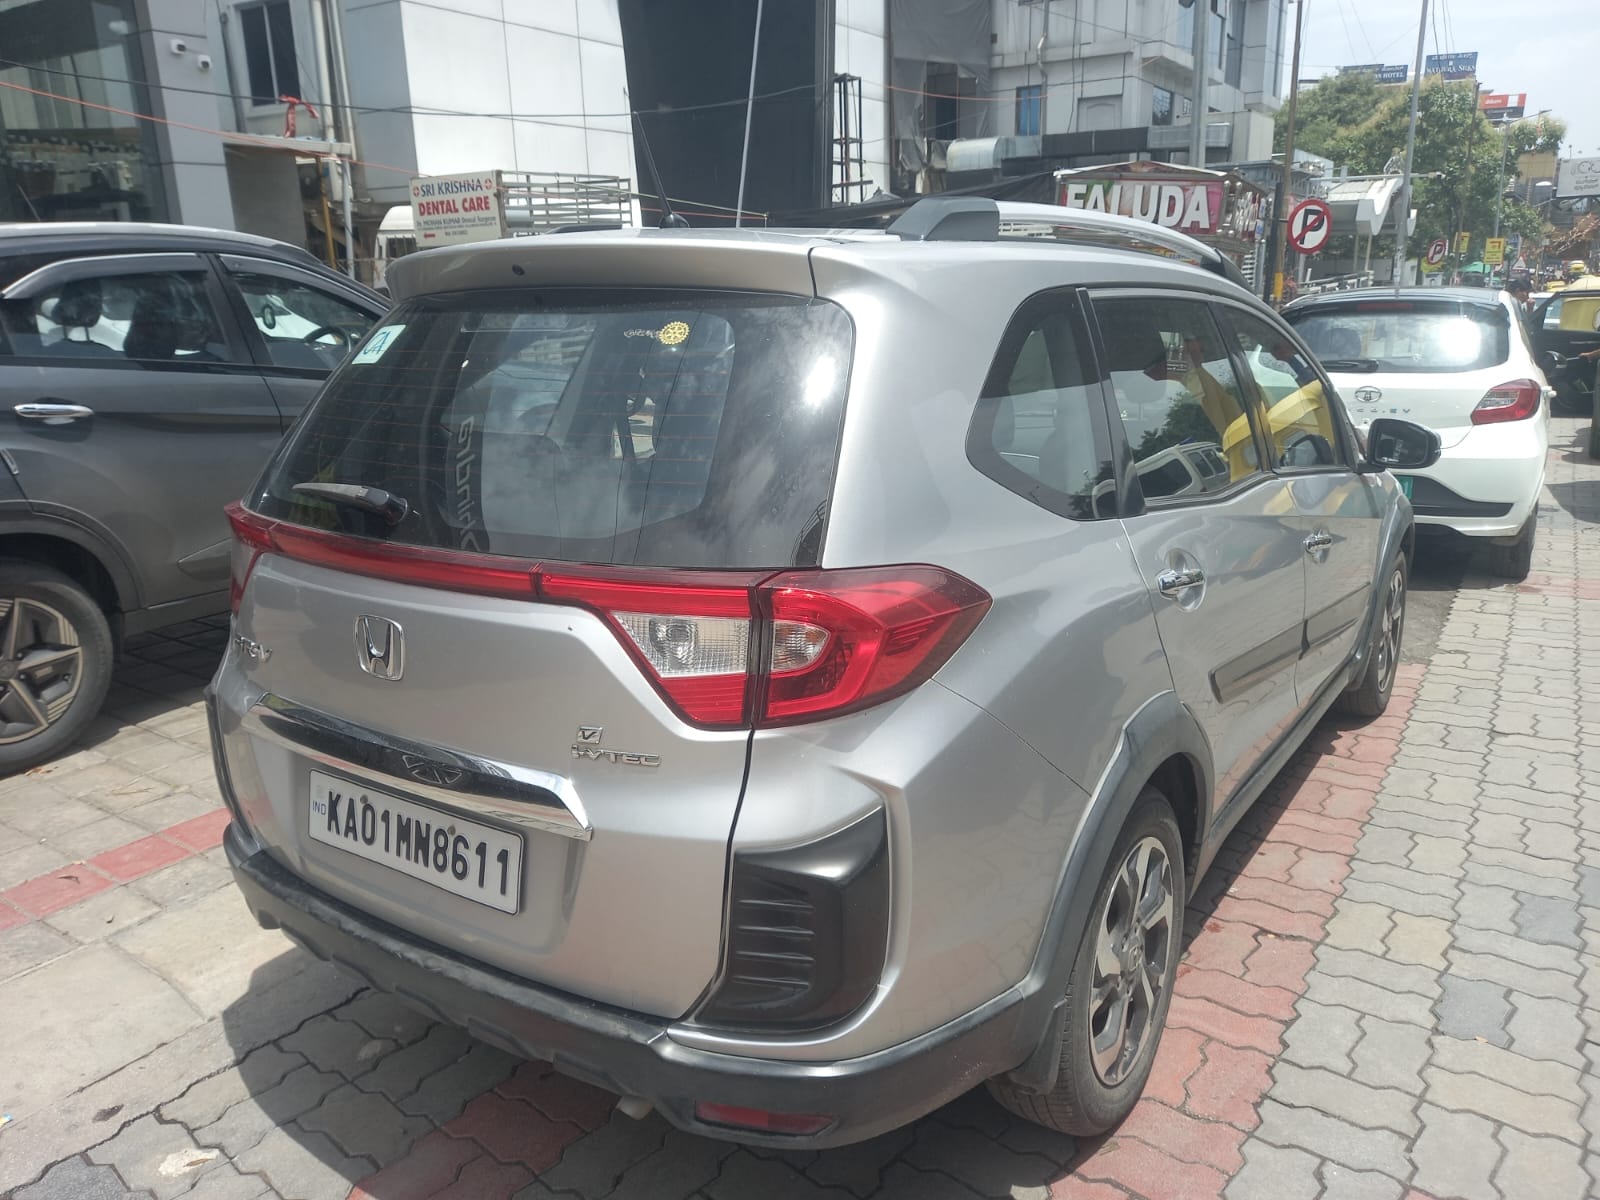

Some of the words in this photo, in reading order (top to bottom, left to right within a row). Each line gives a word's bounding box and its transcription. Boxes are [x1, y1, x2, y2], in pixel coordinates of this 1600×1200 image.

[420, 183, 436, 197] SRI
[437, 178, 483, 195] KRISHNA
[418, 199, 459, 217] DENTAL
[461, 195, 491, 213] CARE
[312, 801, 327, 816] IND
[327, 790, 509, 896] KA01MN8611
